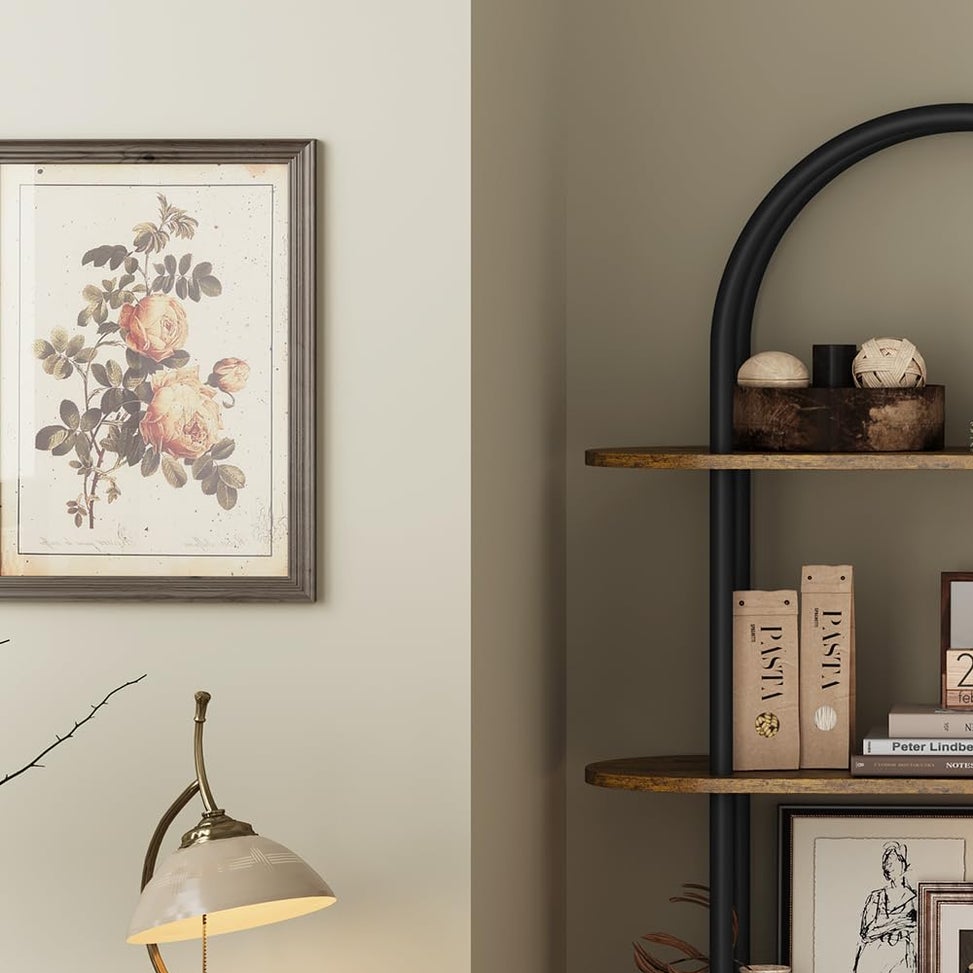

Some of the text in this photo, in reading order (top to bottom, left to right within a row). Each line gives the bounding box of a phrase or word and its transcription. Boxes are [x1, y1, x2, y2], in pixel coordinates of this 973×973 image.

[760, 626, 784, 700] PASTA
[821, 611, 842, 689] PASTA
[892, 742, 926, 752] Peter
